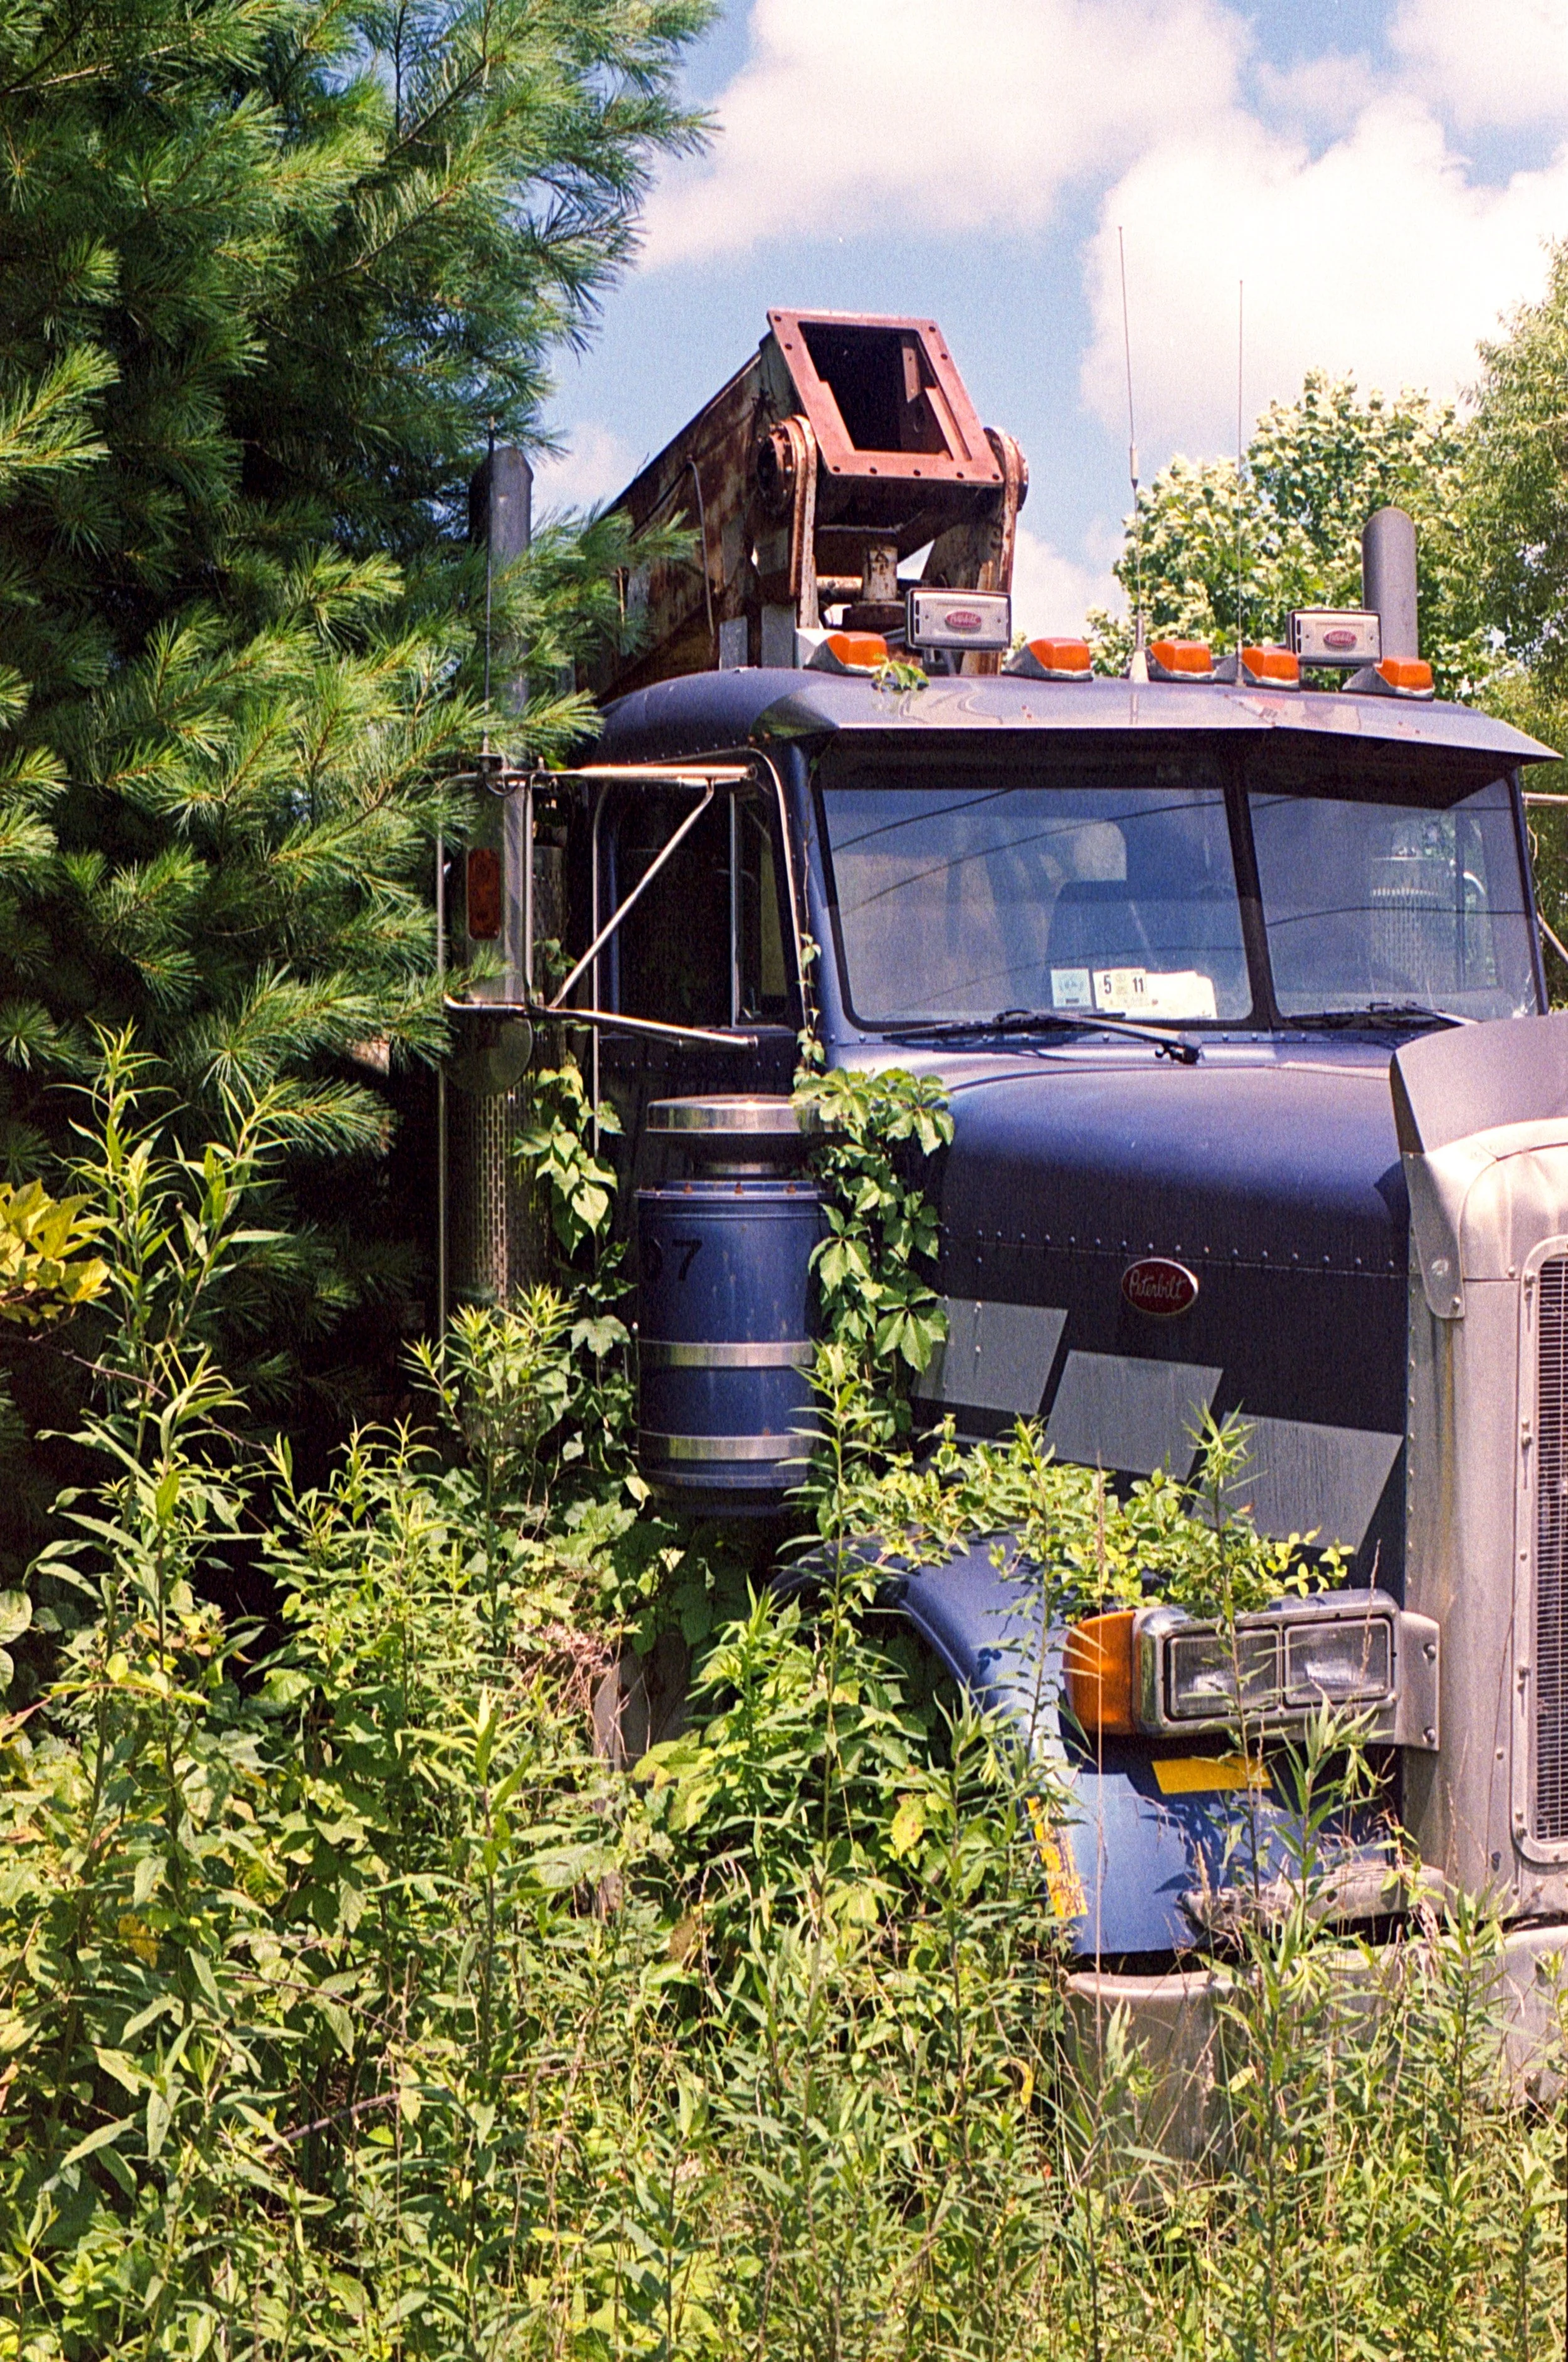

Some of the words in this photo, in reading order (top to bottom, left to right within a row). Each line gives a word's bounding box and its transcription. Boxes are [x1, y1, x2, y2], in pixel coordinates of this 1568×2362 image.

[1104, 974, 1111, 994] 5
[1133, 977, 1143, 992] 11
[1130, 1269, 1187, 1300] Peterbilt
